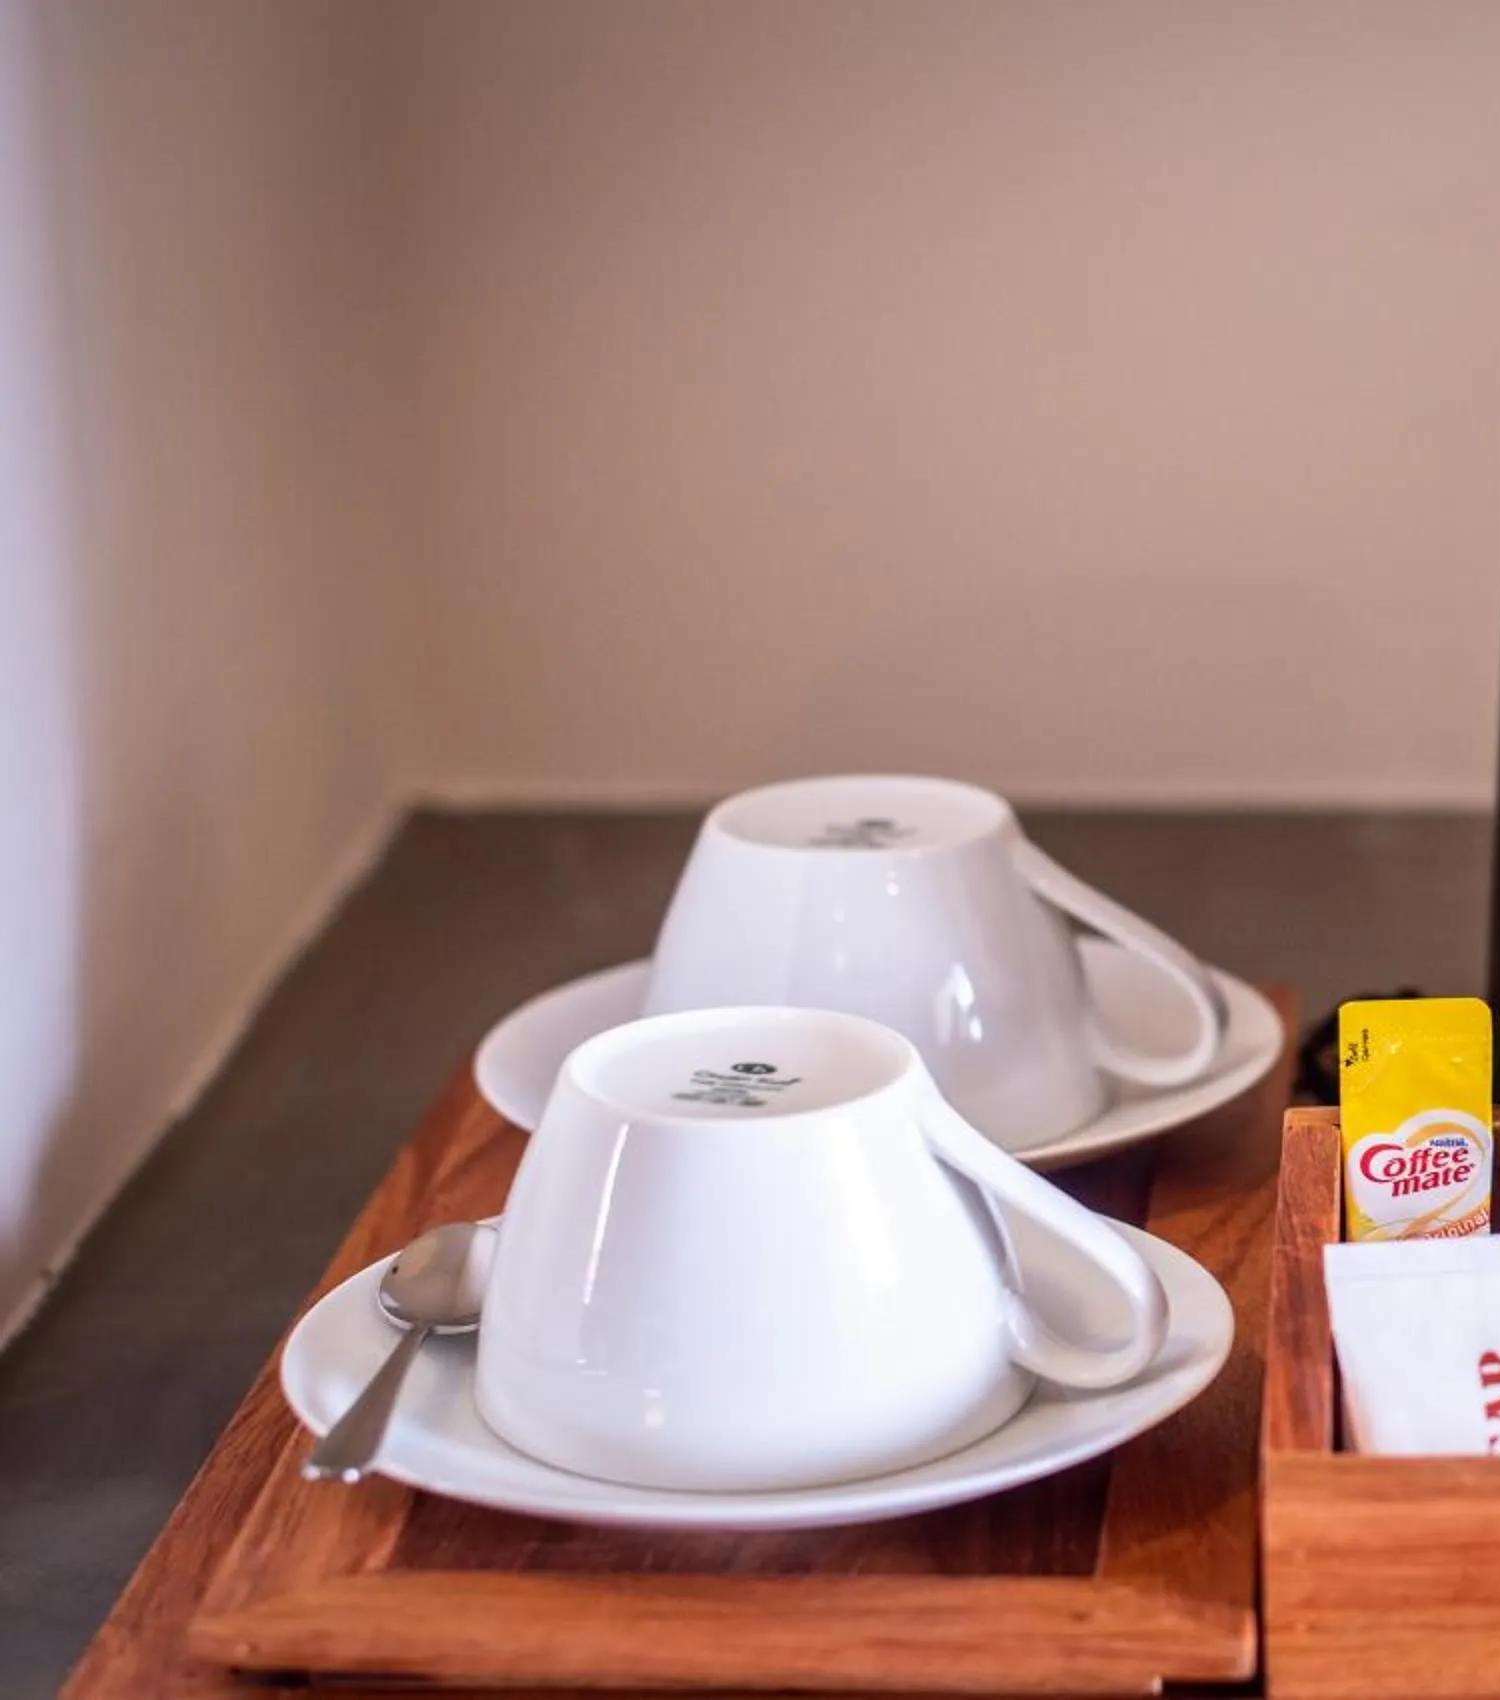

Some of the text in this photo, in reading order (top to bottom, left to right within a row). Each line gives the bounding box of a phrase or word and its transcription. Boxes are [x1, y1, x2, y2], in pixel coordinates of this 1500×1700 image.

[1360, 1144, 1469, 1183] Coffee
[1392, 1165, 1471, 1197] mate
[1424, 1208, 1489, 1239] iginal
